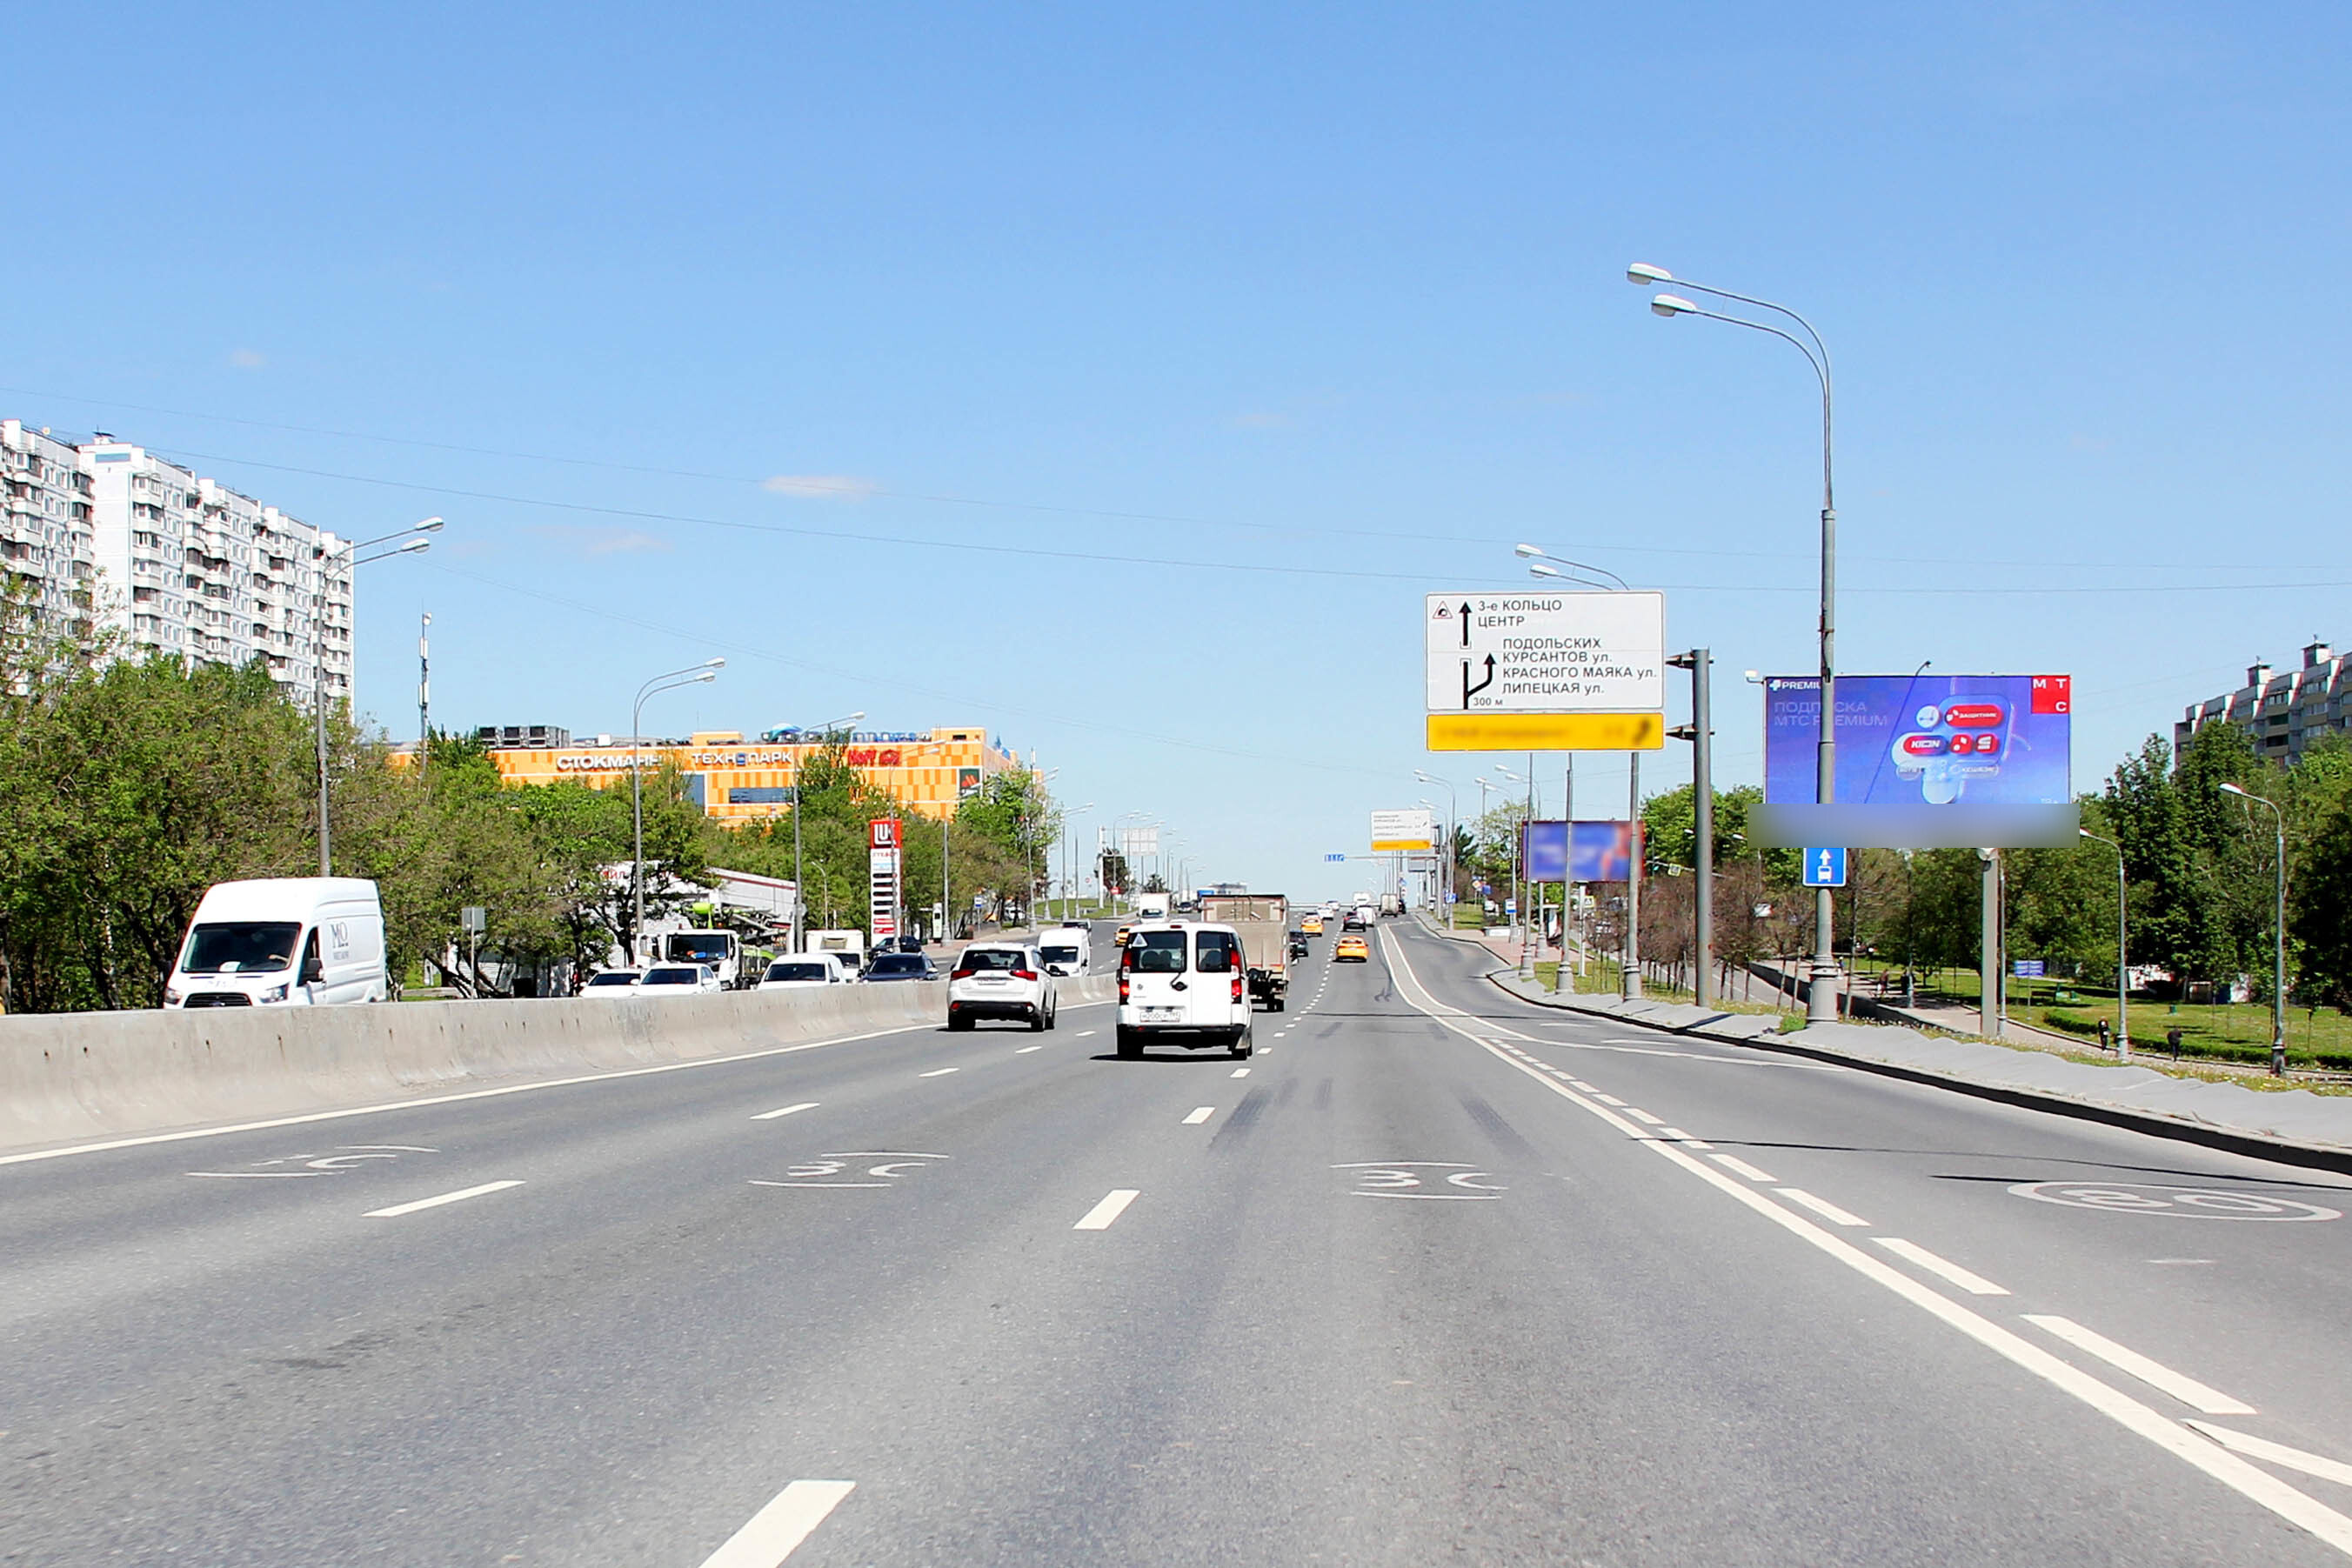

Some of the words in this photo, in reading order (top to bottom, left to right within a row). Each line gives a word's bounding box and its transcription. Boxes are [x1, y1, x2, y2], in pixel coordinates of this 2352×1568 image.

[1479, 600, 1499, 611] 3-е
[1502, 599, 1563, 612] КОЛЬЦО
[1478, 616, 1526, 629] ЦЕНТР
[1502, 637, 1601, 651] ПОДОЛЬСКИХ
[1502, 651, 1588, 663] КУРСАНТОВ
[1592, 654, 1613, 665] ул.
[1502, 666, 1579, 678] КРАСНОГО
[1582, 666, 1634, 678] МАЯКА
[1636, 669, 1657, 681] ул.
[1501, 682, 1580, 695] ЛИПЕЦКАЯ
[1584, 684, 1605, 697] ул.
[1473, 697, 1492, 706] 300
[1774, 701, 1868, 714] ПОДПСКА
[1813, 714, 1888, 727] PEMIUM
